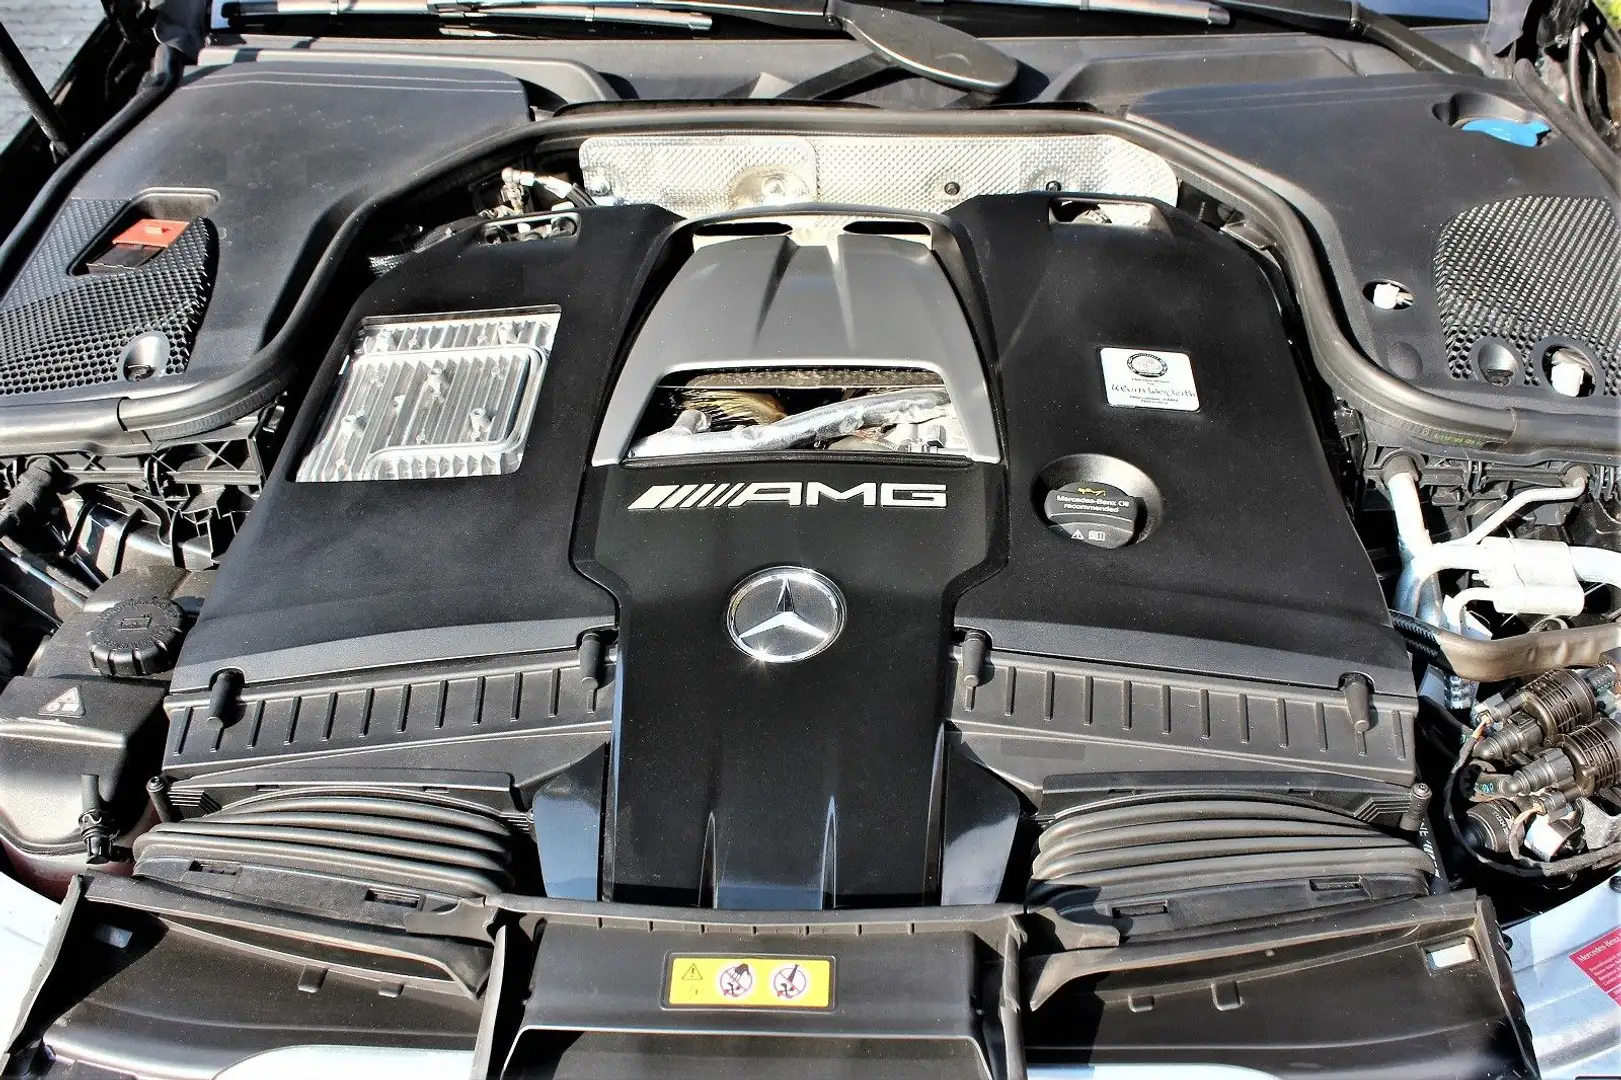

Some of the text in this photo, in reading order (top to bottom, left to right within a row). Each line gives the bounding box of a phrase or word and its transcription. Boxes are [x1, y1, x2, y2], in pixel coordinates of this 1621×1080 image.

[728, 482, 947, 508] AMG
[1056, 495, 1130, 508] Mercedes-Benz Oil
[1064, 503, 1119, 513] recommended
